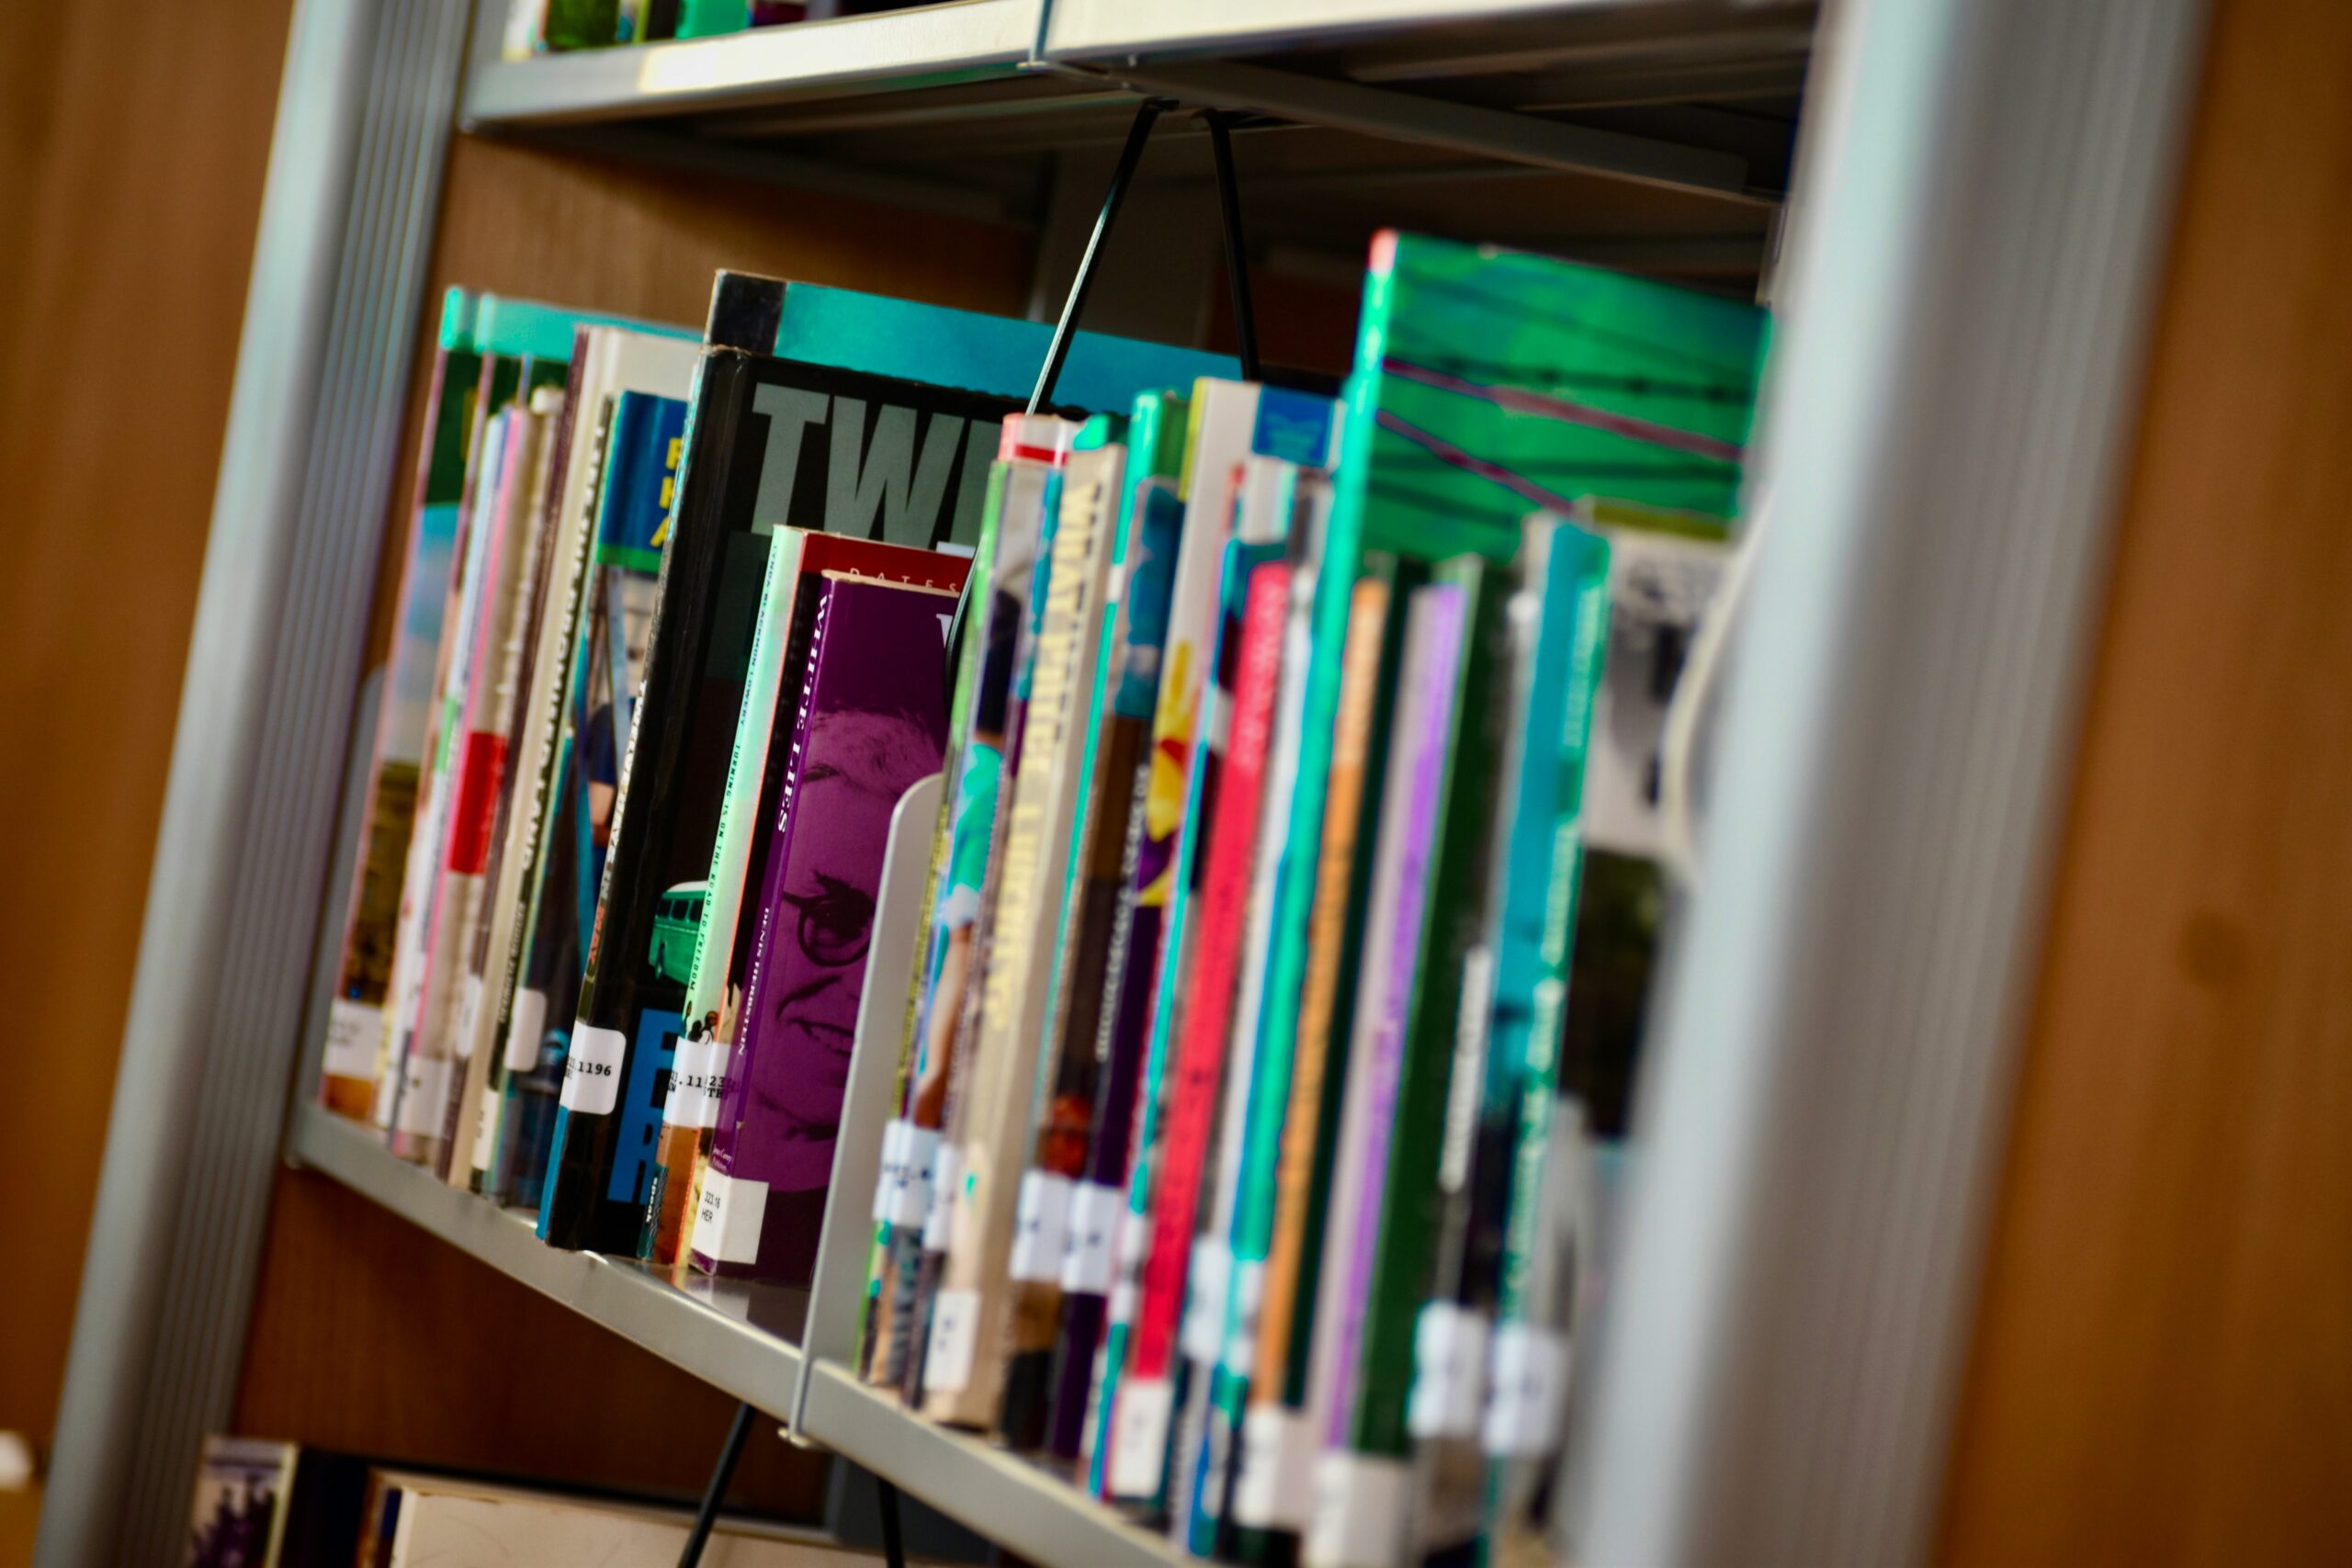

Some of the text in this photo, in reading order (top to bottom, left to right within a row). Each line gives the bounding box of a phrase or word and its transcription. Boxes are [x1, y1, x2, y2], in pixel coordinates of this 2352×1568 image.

[751, 592, 768, 666] BLACKMON
[794, 594, 830, 730] WHITE
[775, 740, 802, 832] LIES
[587, 905, 605, 964] MAY
[689, 932, 704, 990] FREEDOM
[736, 907, 771, 1055] DENIS HERBSTEIN
[646, 1177, 658, 1223] speak
[701, 1208, 714, 1224] HER
[705, 1190, 721, 1210] 323.16
